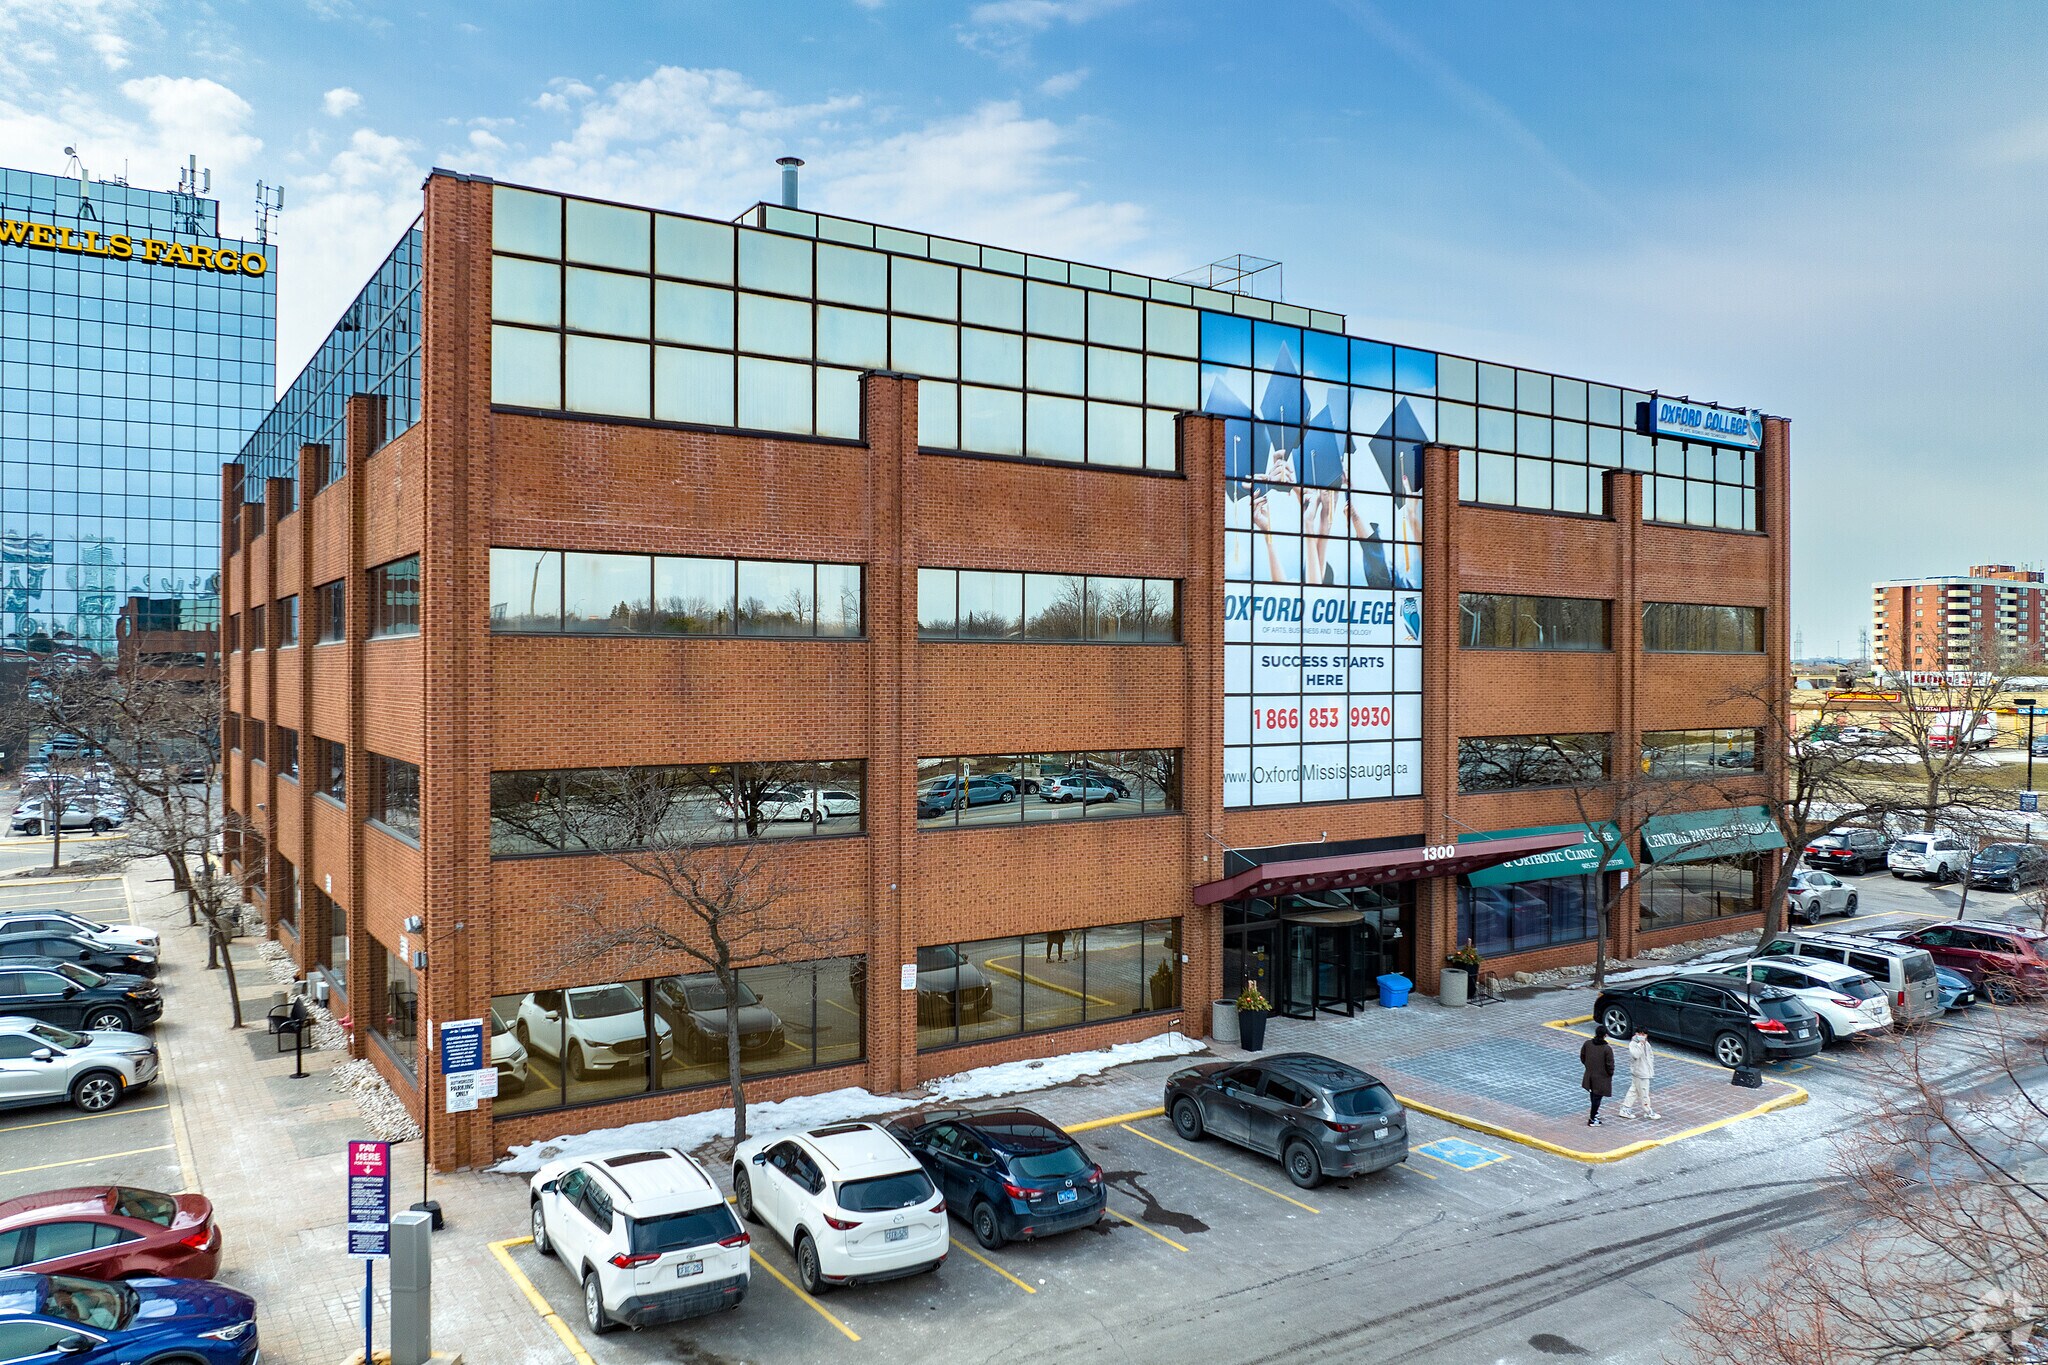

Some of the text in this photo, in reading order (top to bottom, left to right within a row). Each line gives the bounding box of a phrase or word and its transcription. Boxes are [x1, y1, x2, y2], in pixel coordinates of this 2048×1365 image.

[0, 218, 268, 276] WELLS FARGO
[1660, 403, 1702, 428] OXFORD
[1705, 411, 1749, 436] COLLEGE
[1225, 594, 1396, 625] OXFORD COLLEGE
[1261, 656, 1385, 668] SUCCESS STARTS
[1306, 674, 1344, 686] HERE
[1254, 706, 1391, 730] 1 866 853 9930
[1588, 831, 1614, 843] CRE
[1646, 831, 1691, 848] CENTRAL
[1422, 845, 1455, 860] 1300
[1513, 852, 1564, 867] ORTHOTIC
[1564, 848, 1598, 861] CLINIC
[450, 1084, 474, 1092] PARKING
[359, 1144, 377, 1152] PAY
[355, 1152, 381, 1161] HERE
